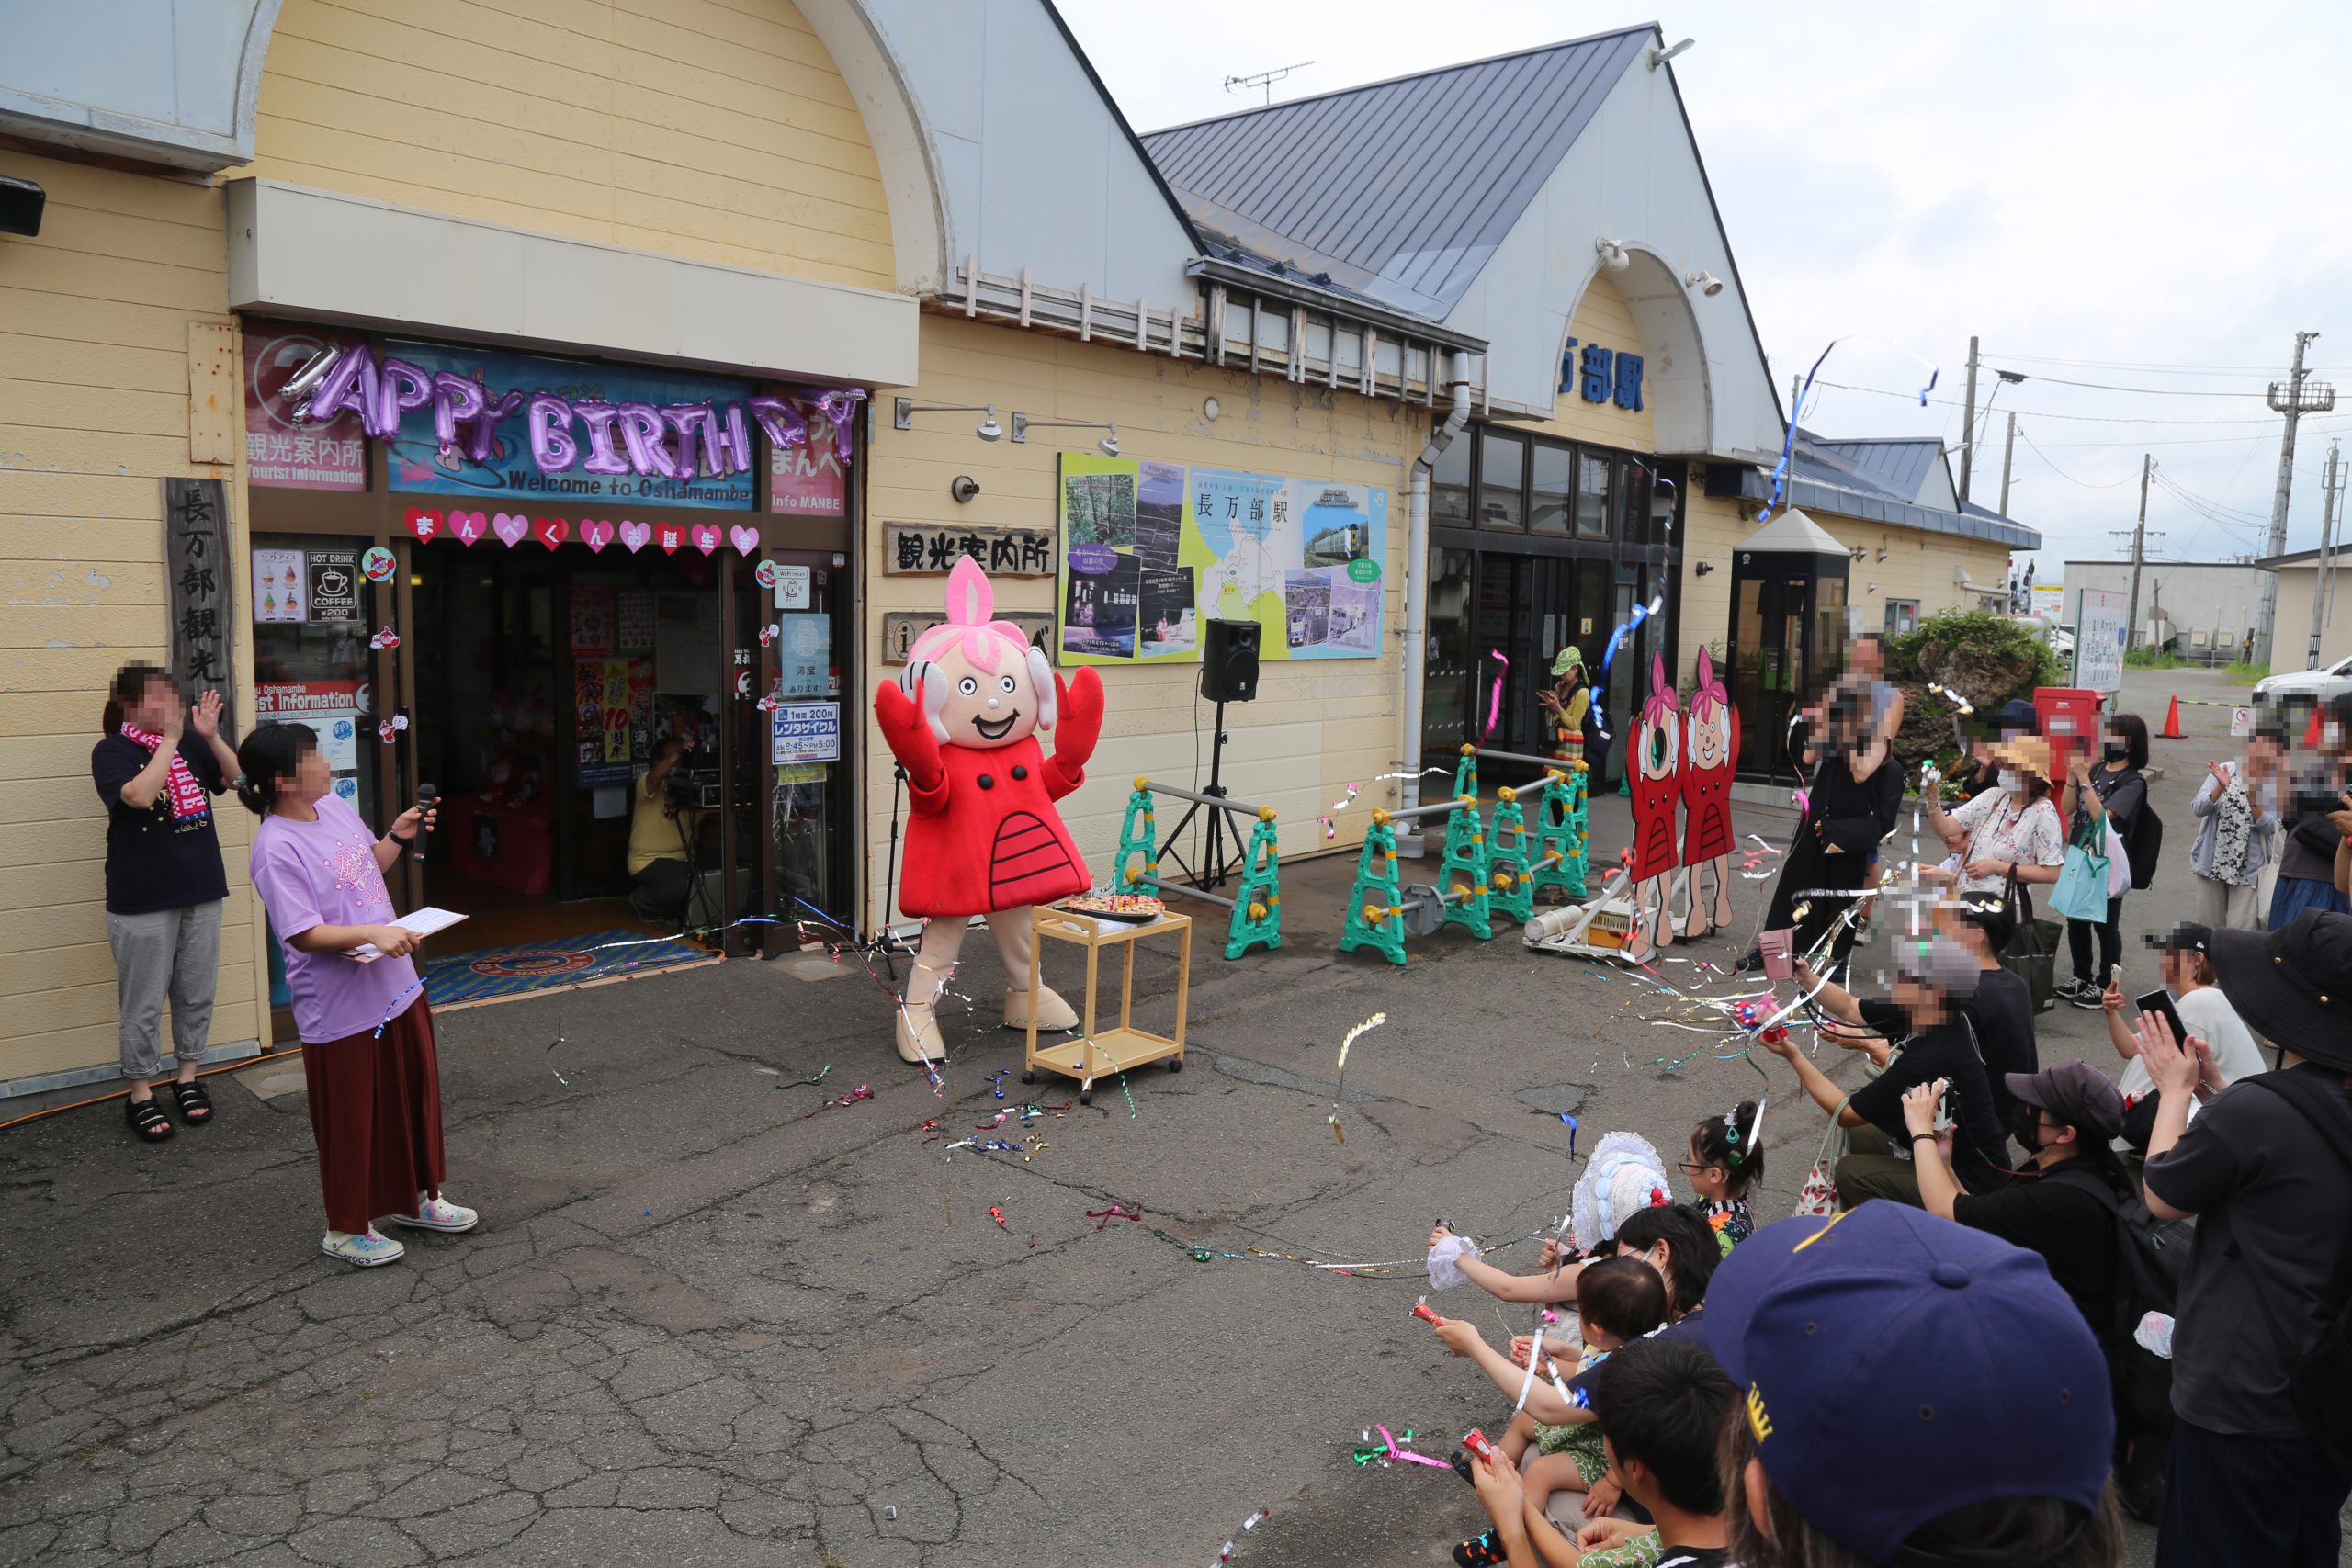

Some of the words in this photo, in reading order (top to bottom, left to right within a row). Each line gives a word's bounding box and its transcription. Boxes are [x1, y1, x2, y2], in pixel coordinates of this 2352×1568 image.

[277, 343, 525, 468] APPY
[246, 432, 364, 468] 観光案内所
[292, 467, 363, 484] Information
[772, 448, 841, 479] まんべ
[508, 470, 601, 495] Welcome
[609, 477, 632, 498] to
[639, 479, 749, 502] Oshamambe
[772, 494, 797, 508] Info
[800, 497, 840, 510] MANBE
[1197, 492, 1288, 524] 長万部駅
[415, 515, 752, 550] まんべくんお誕生会
[310, 554, 327, 562] HOT
[330, 555, 354, 563] DRINK
[897, 532, 1050, 572] 観光案内所
[175, 488, 226, 707] 長万部観光
[314, 597, 353, 606] COFFEE
[322, 608, 348, 616] ¥200
[263, 684, 306, 694] Oshamambe
[278, 692, 354, 710] Information
[791, 711, 808, 720] 1時間
[809, 708, 833, 719] 200円
[775, 721, 836, 736] レンタサイクル
[172, 749, 208, 810] URSE
